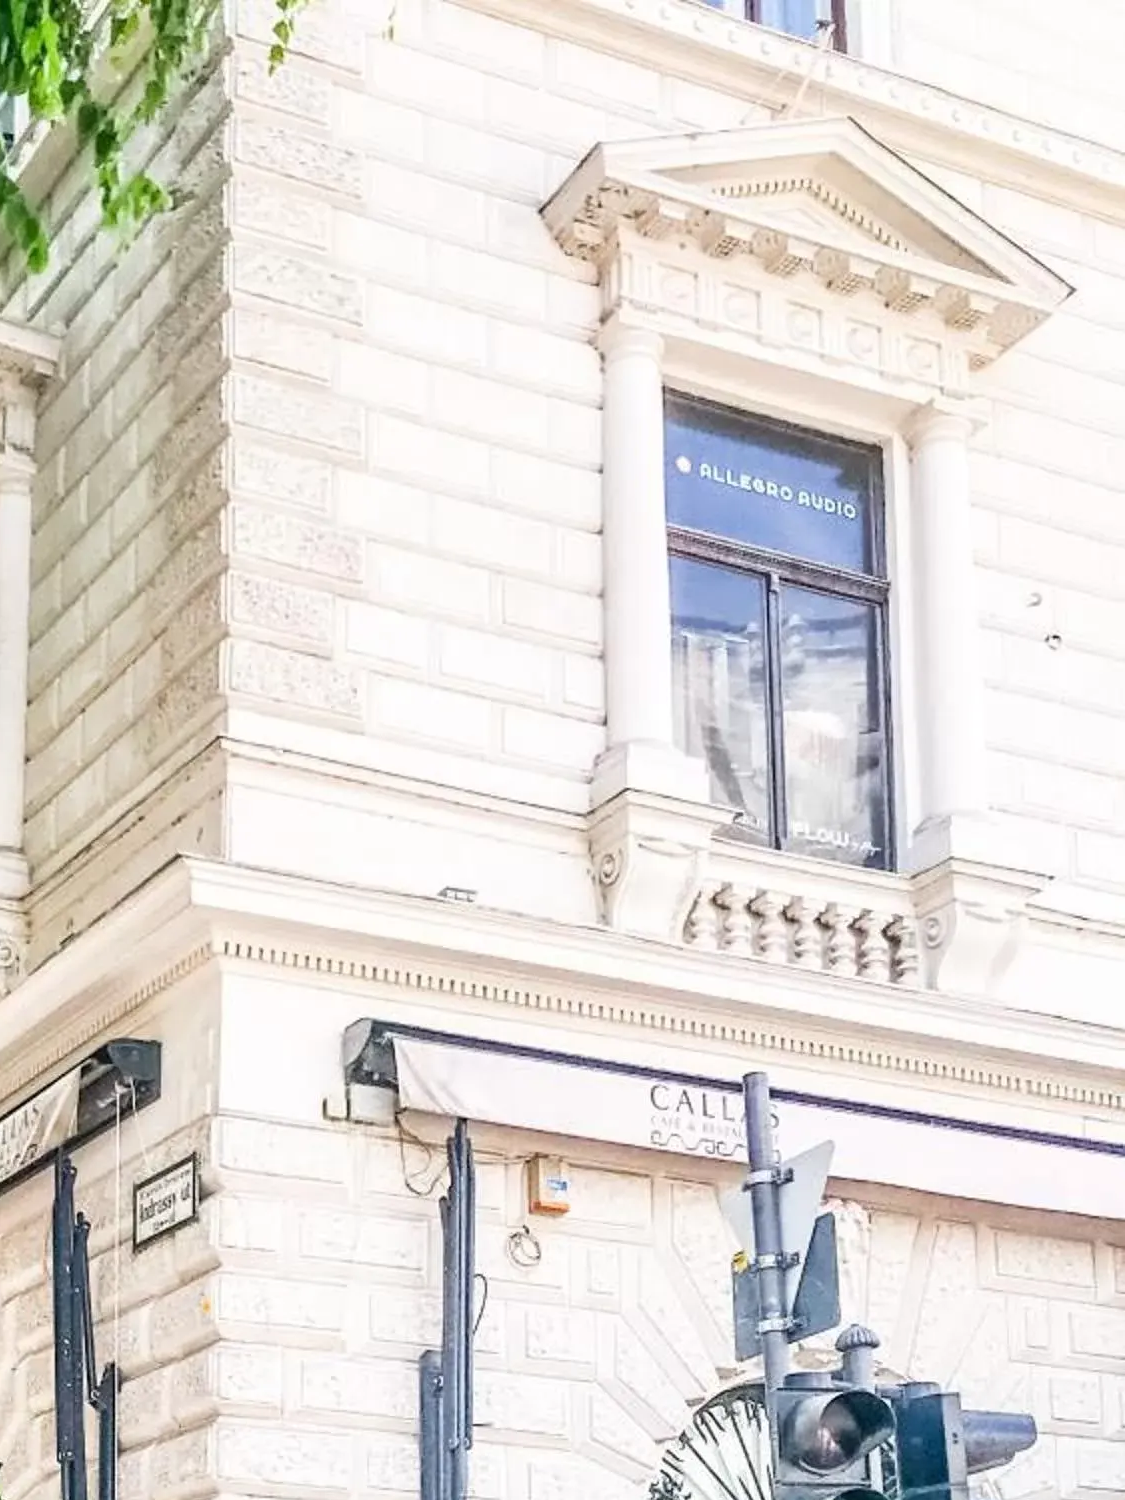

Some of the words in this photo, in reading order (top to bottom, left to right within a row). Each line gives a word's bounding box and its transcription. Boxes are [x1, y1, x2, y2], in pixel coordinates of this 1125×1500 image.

[700, 463, 793, 501] ALLEGRO
[798, 491, 857, 520] AUDIO
[650, 1084, 780, 1128] CALLS
